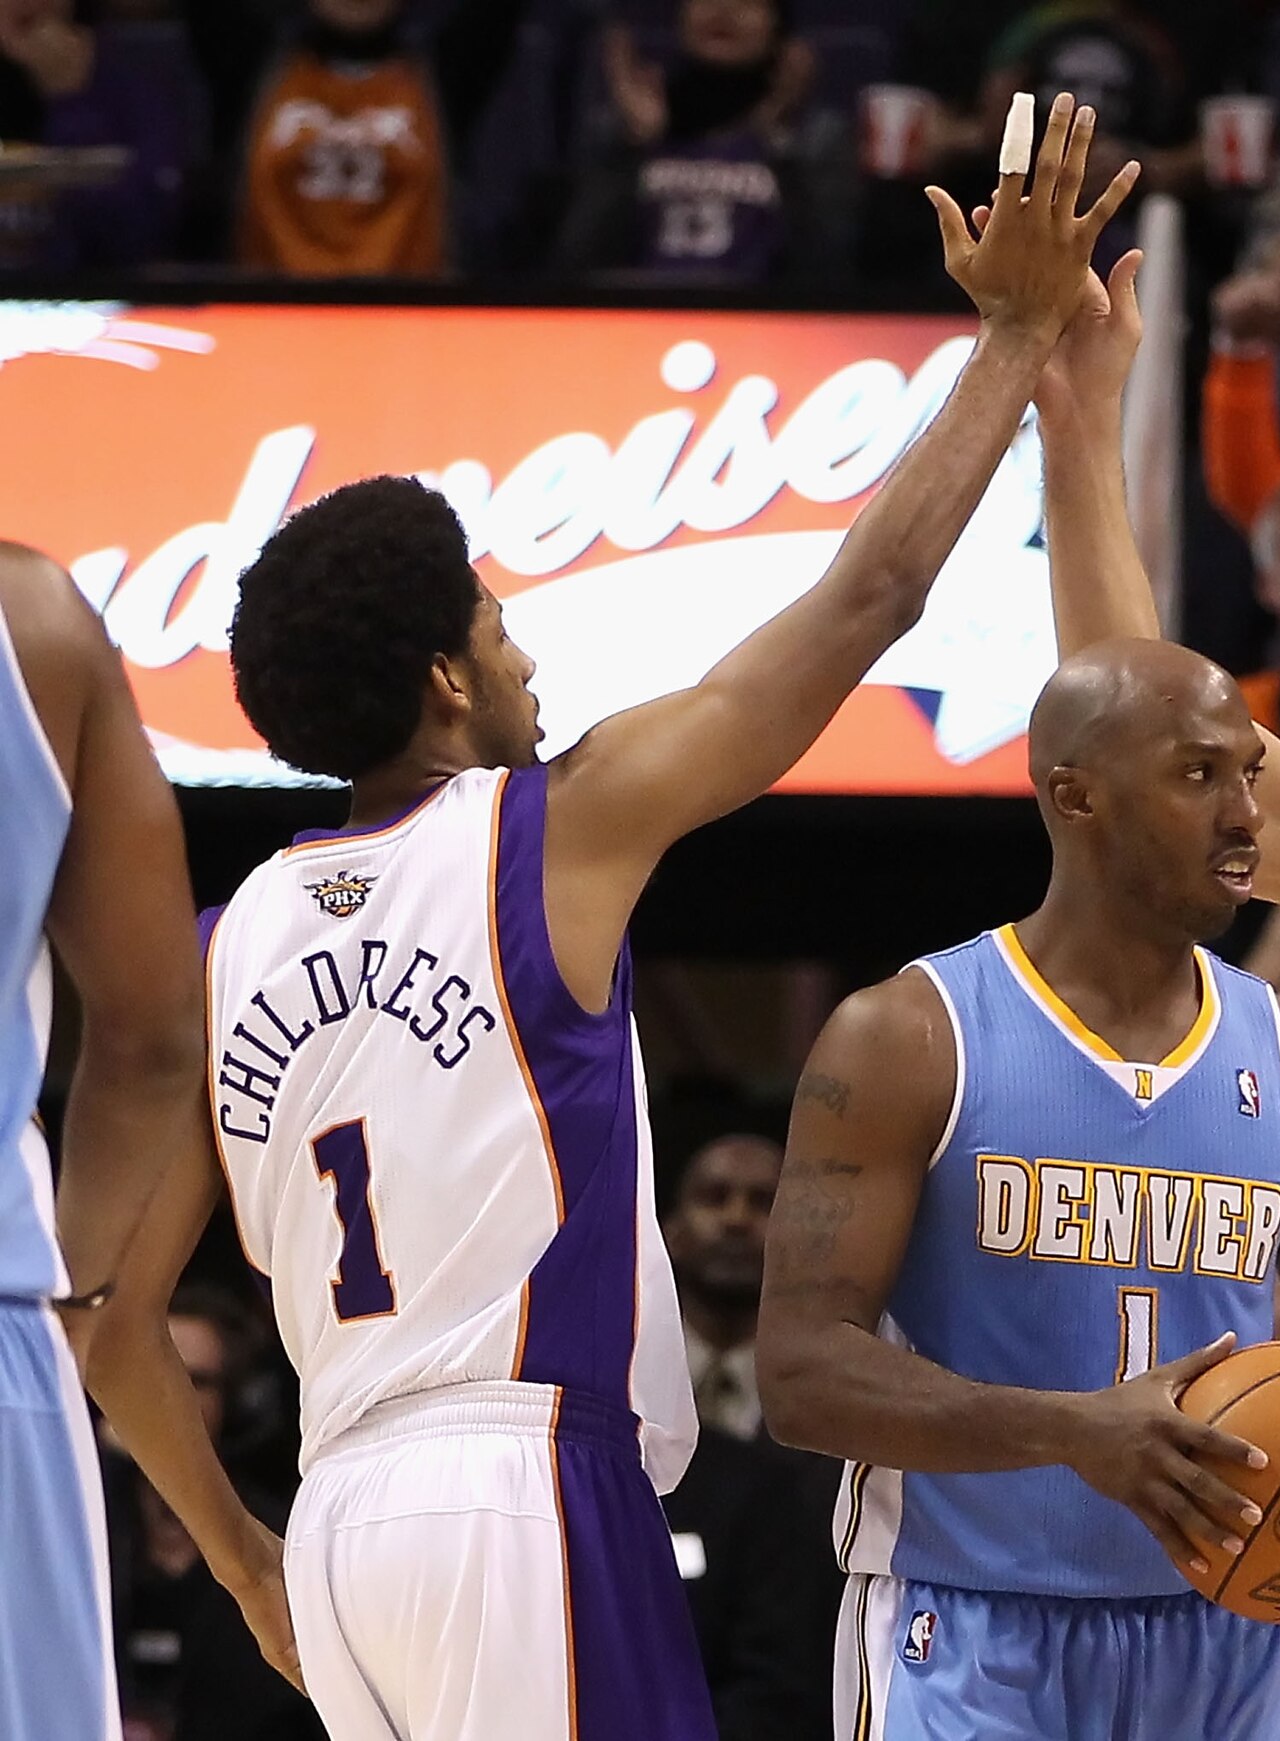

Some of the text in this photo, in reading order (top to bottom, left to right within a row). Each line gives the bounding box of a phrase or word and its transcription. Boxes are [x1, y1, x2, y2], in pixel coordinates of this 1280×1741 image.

[323, 890, 363, 907] PHX
[220, 940, 495, 1143] CHILDRESS
[1135, 1069, 1152, 1100] N
[309, 1115, 397, 1325] 1
[1114, 1285, 1159, 1386] 1
